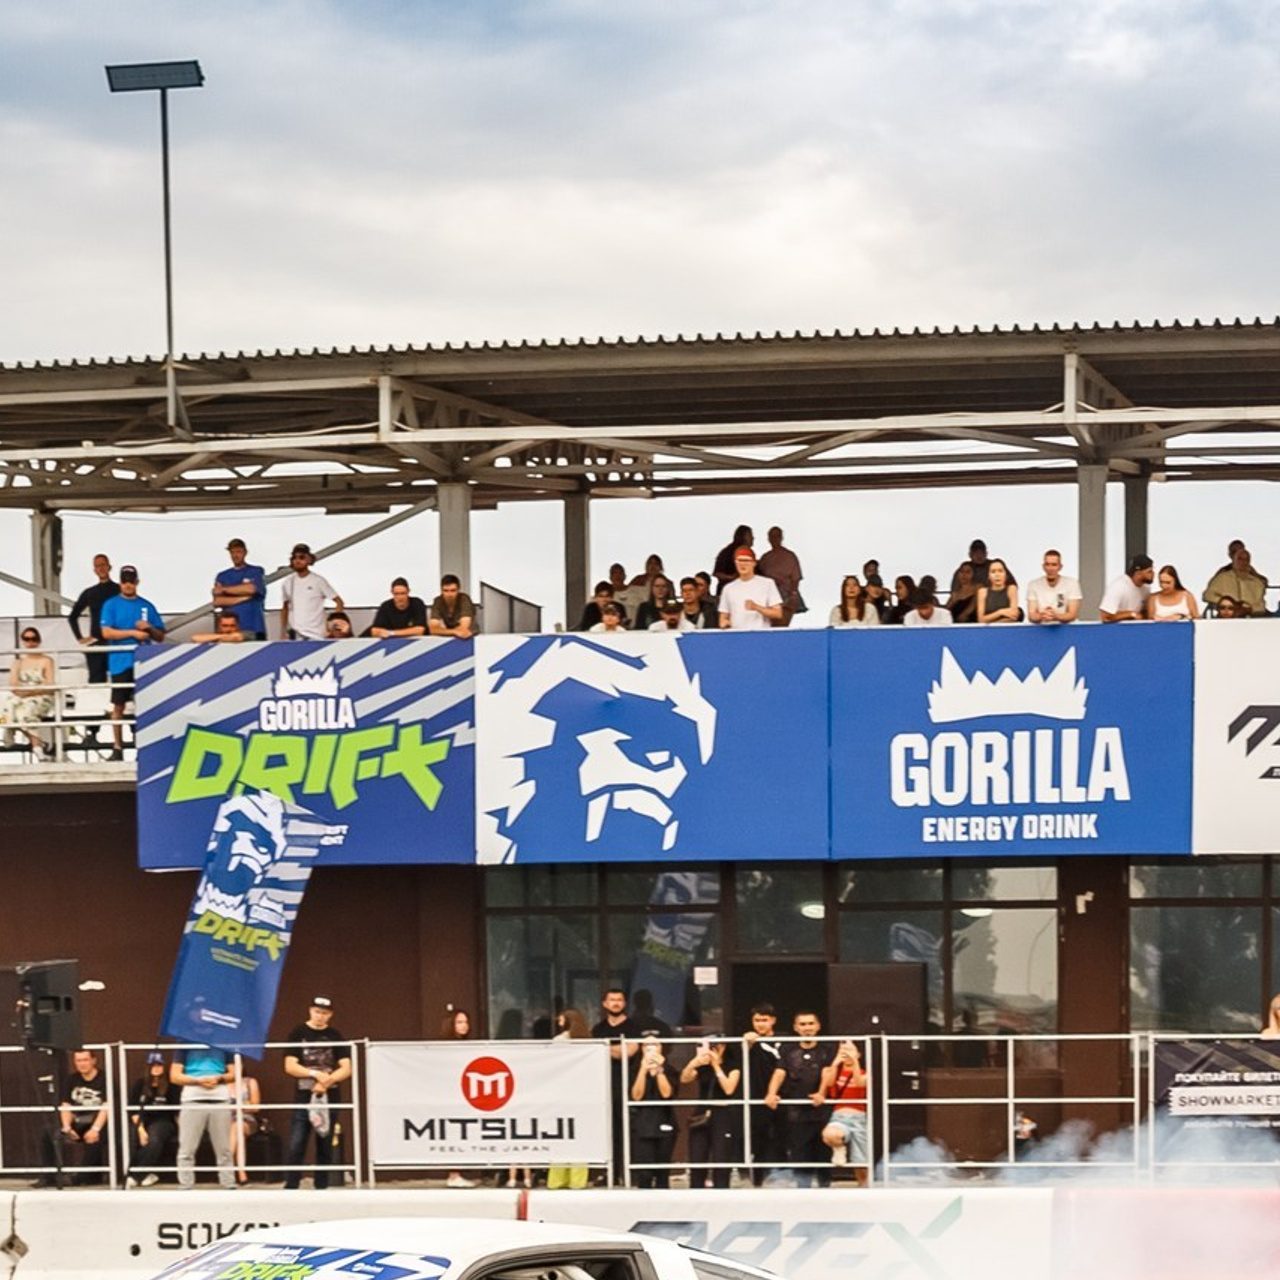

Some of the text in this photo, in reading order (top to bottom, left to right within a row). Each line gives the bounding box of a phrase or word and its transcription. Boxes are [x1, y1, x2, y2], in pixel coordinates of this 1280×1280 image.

[259, 697, 357, 732] GORILLA
[890, 726, 1132, 807] GORILLA
[922, 813, 1098, 842] ENERGY DRINK
[403, 1117, 576, 1141] MITSUJI
[429, 1145, 551, 1153] FEEL THE JAPAN
